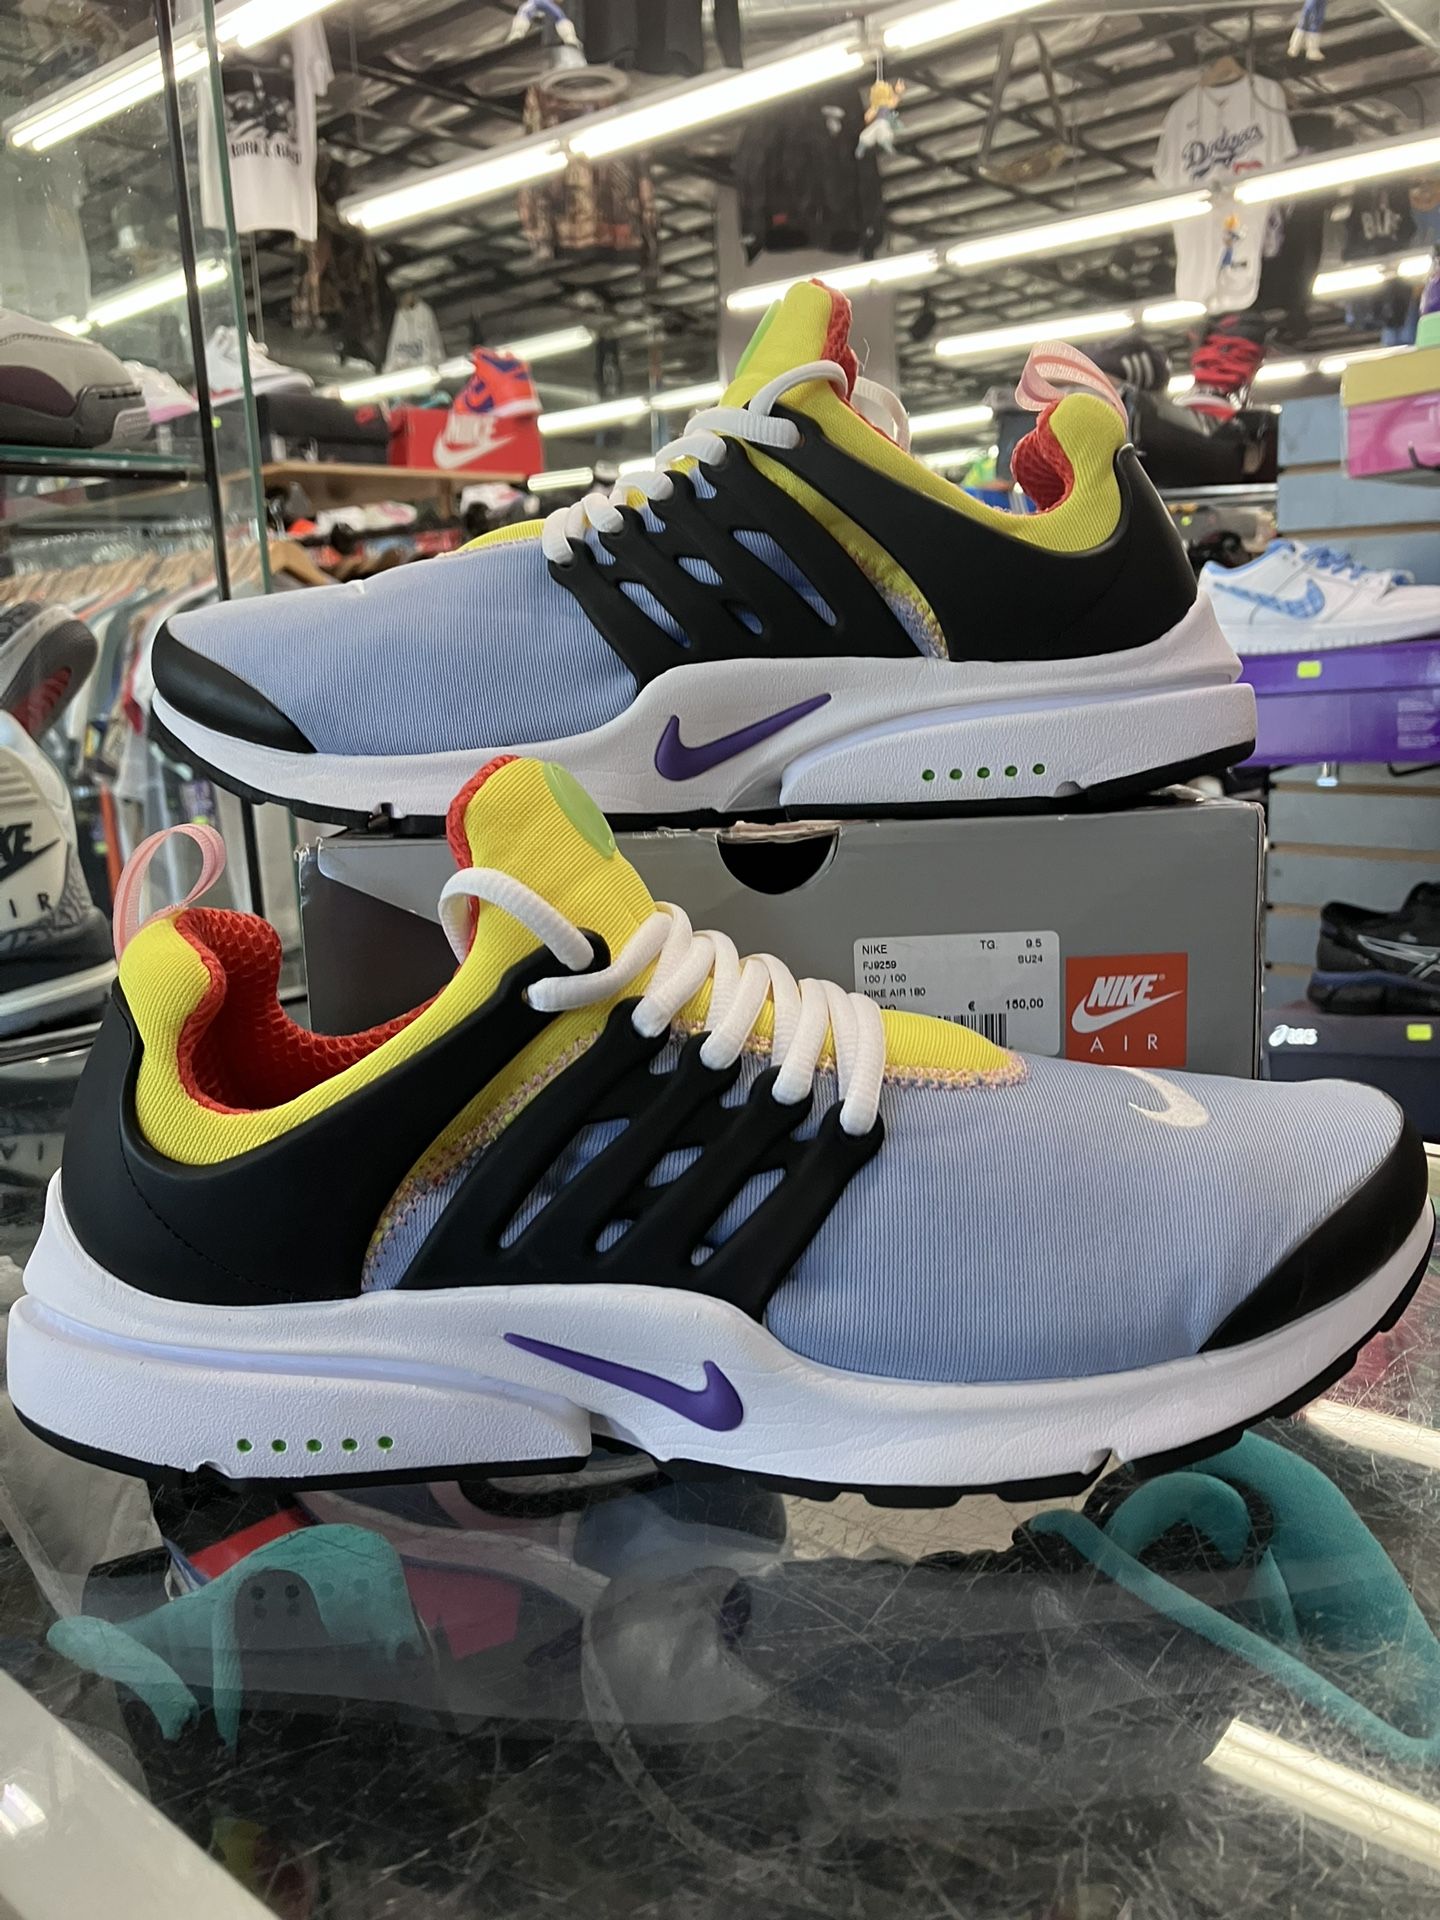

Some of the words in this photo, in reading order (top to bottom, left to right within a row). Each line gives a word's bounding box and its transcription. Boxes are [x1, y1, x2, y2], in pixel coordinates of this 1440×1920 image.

[0, 822, 33, 858] KE
[9, 892, 51, 919] IR
[862, 944, 888, 955] NIKE
[864, 975, 881, 984] 100
[890, 973, 907, 983] 100
[863, 988, 886, 999] NIKE
[889, 988, 906, 998] AIR
[1086, 973, 1158, 1008] NIKE
[1090, 1032, 1158, 1053] AIR
